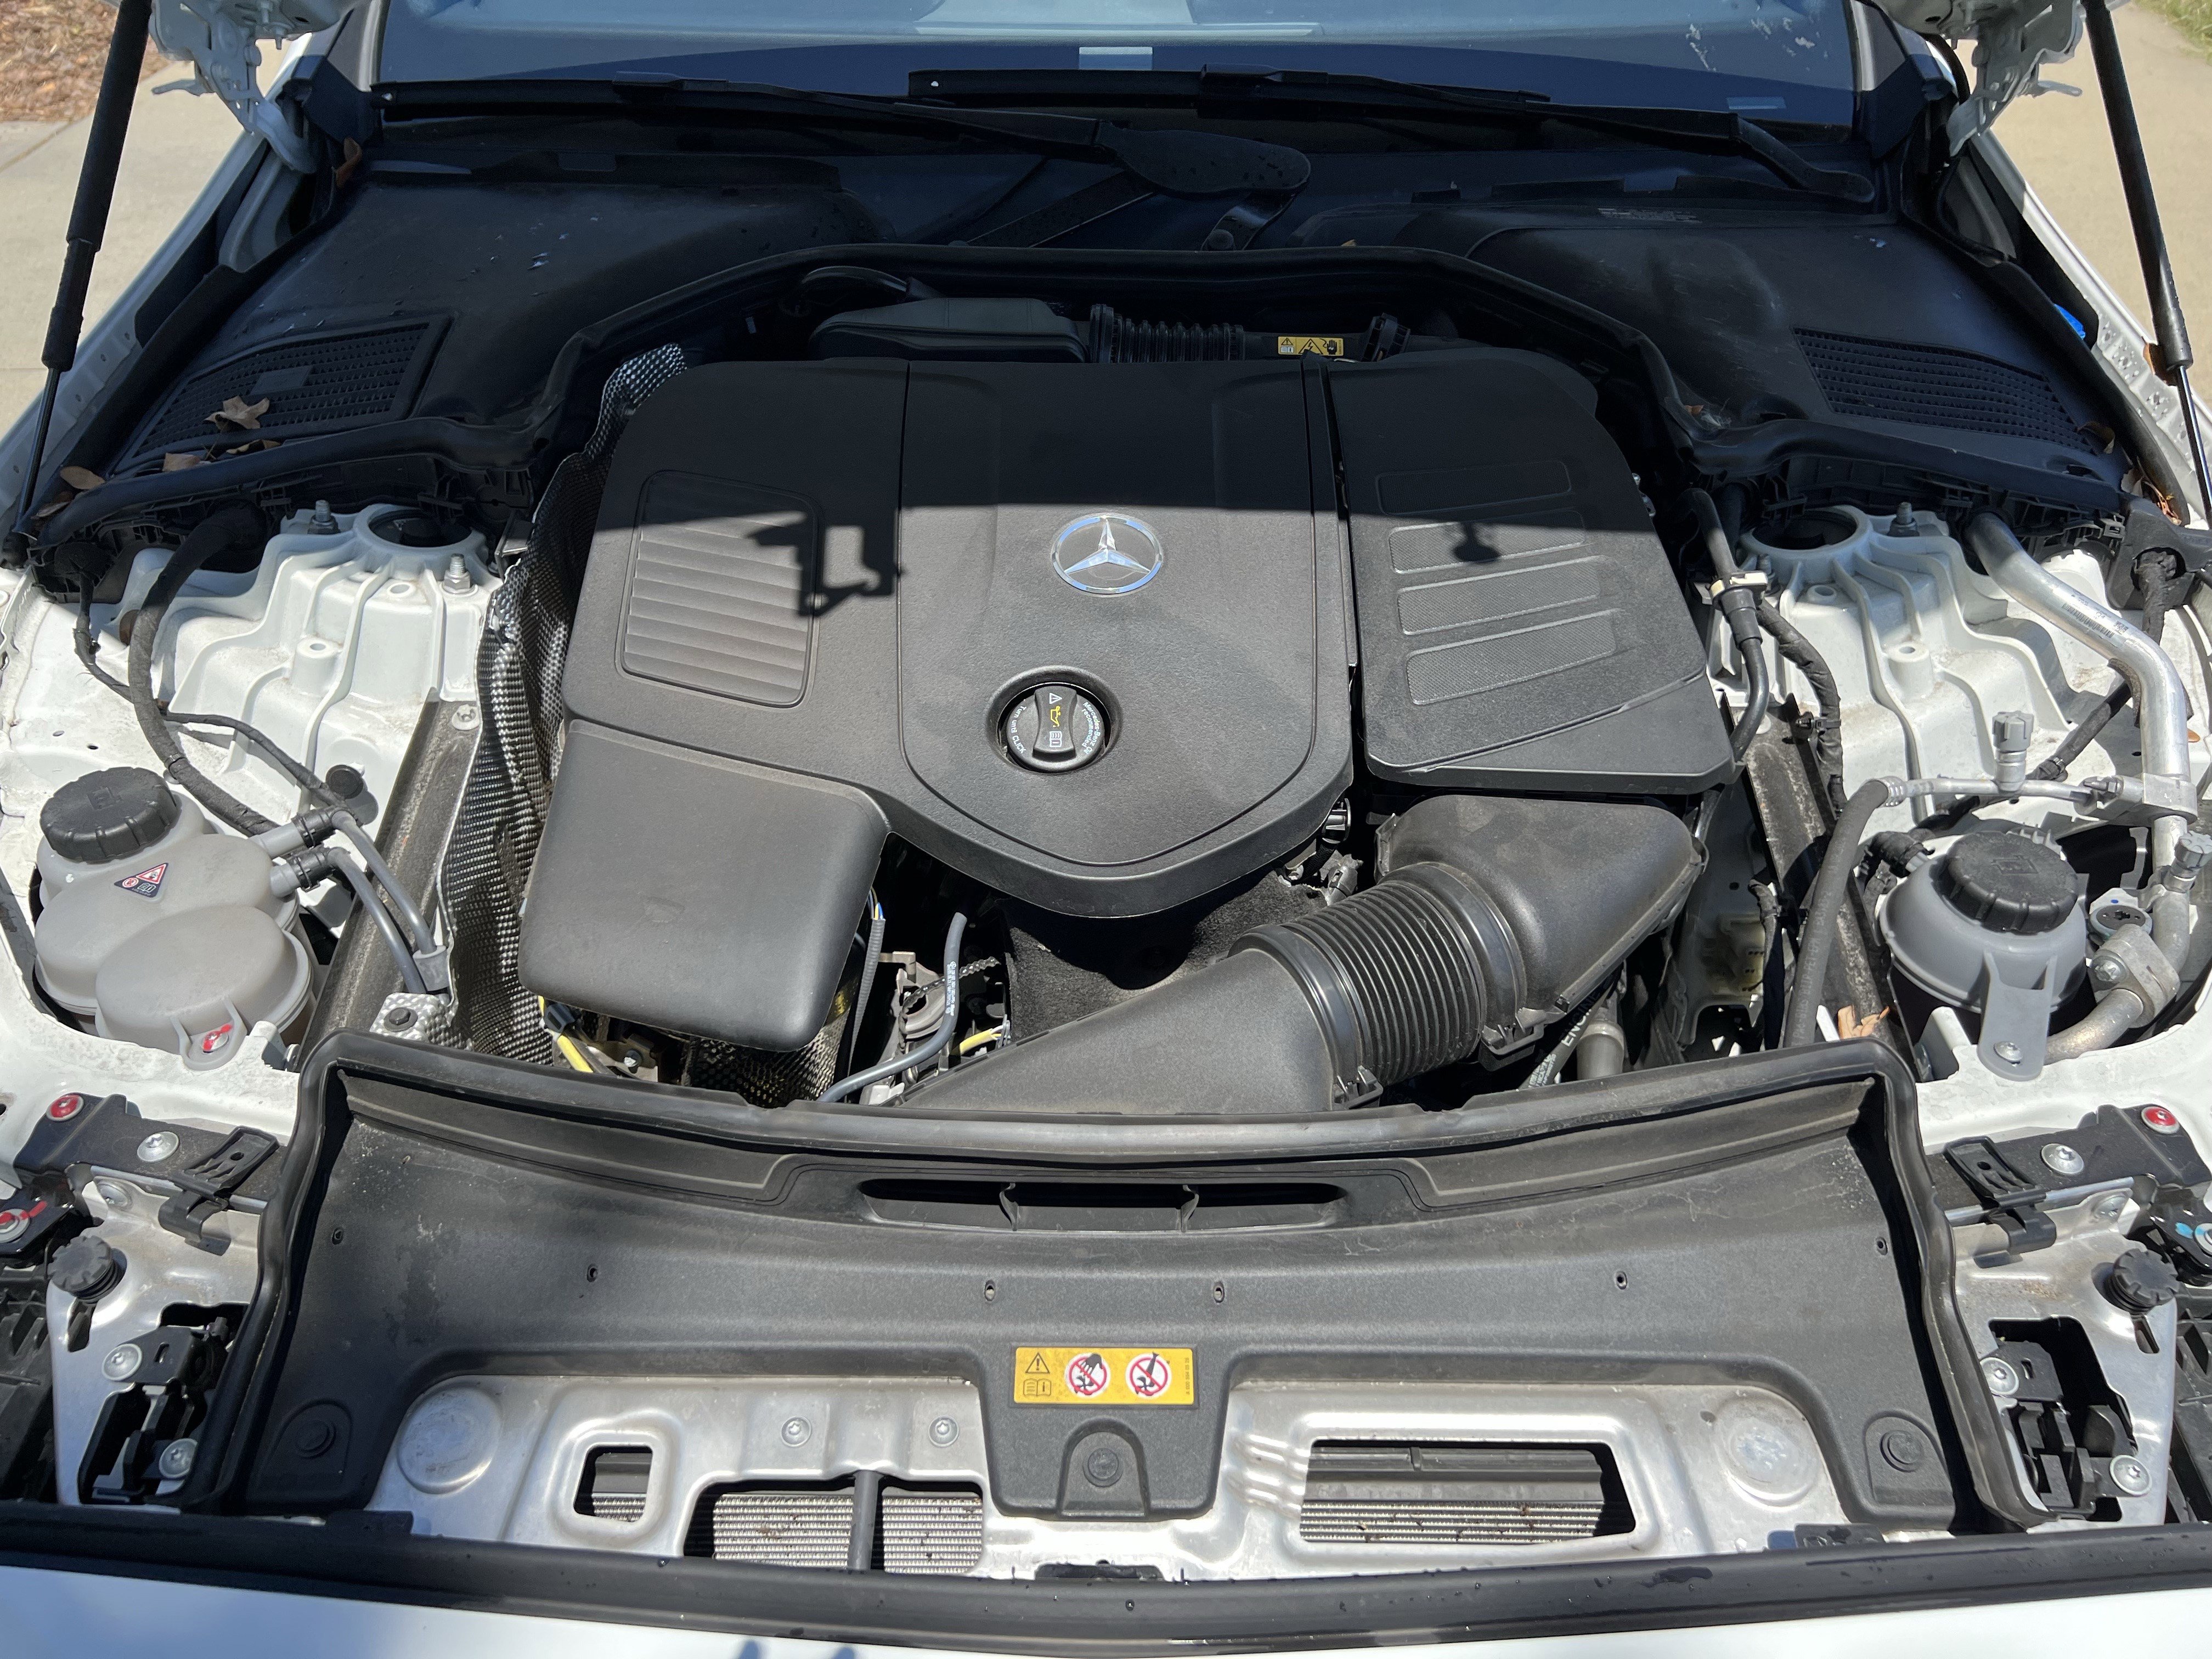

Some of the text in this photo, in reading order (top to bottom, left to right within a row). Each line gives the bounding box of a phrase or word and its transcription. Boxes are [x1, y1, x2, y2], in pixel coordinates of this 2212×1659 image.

[1014, 706, 1026, 718] Turn
[1083, 702, 1101, 746] Mercedes-Benz
[1081, 709, 1093, 748] recommended
[1012, 735, 1026, 754] CLICK
